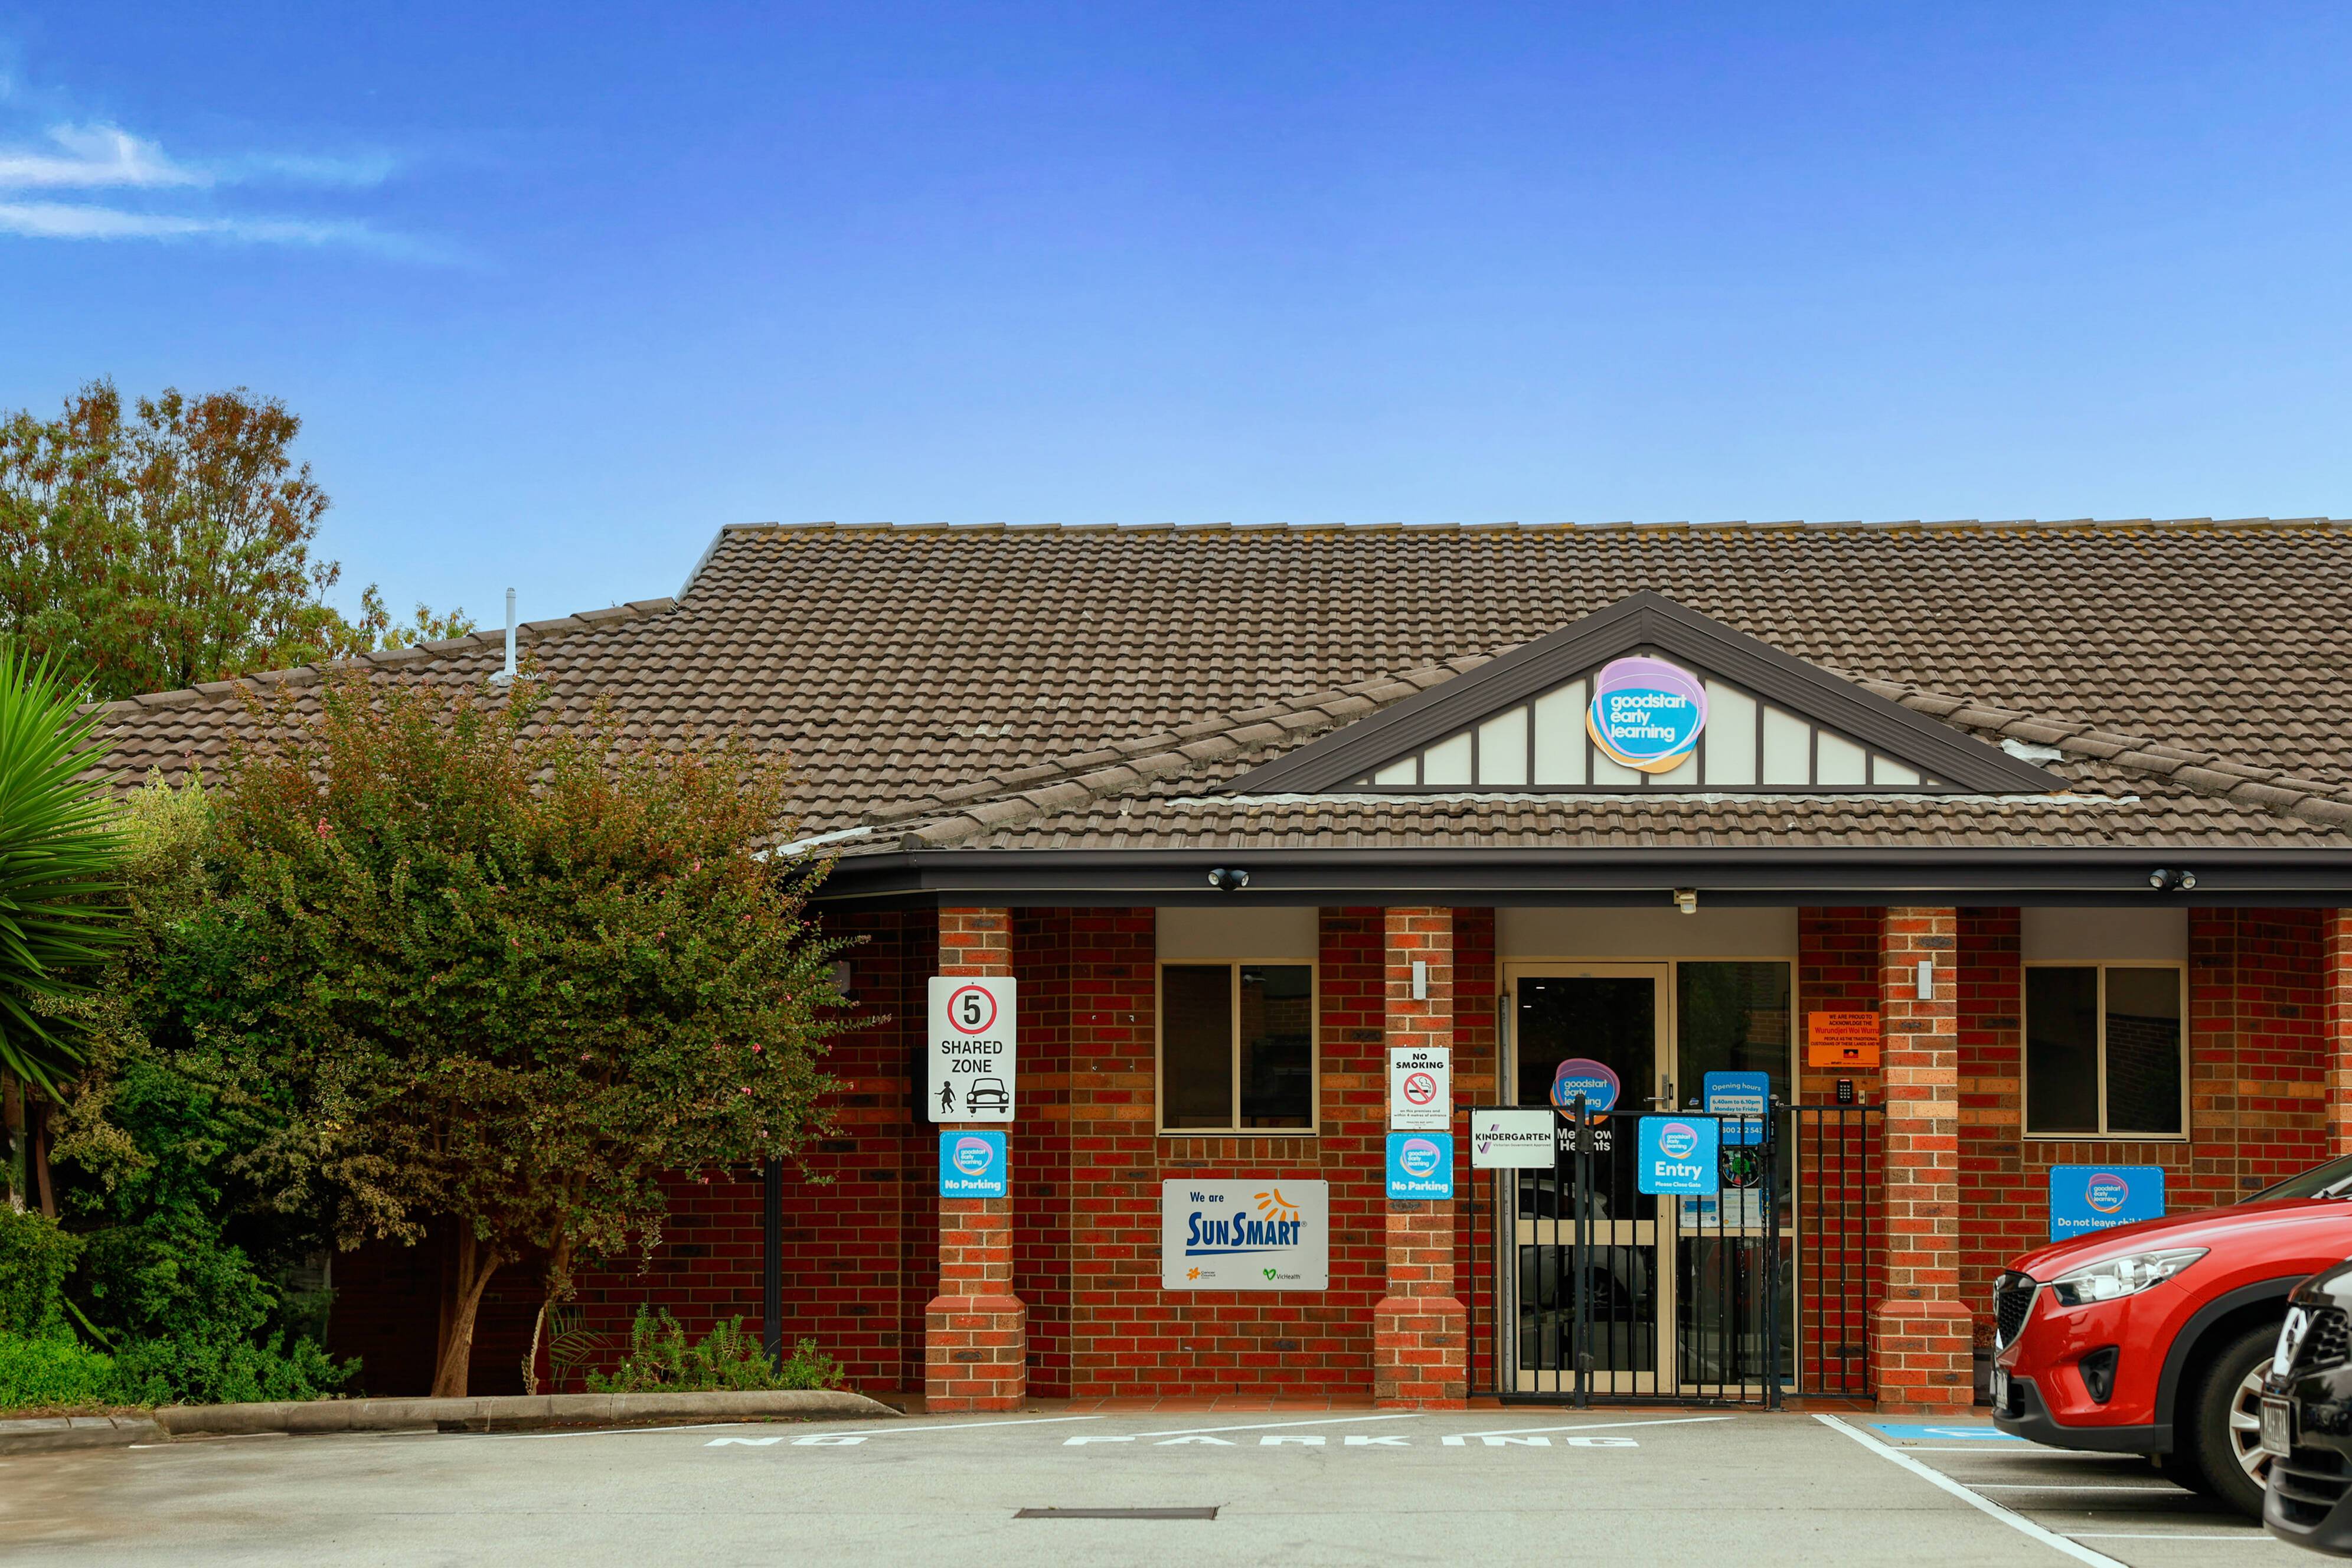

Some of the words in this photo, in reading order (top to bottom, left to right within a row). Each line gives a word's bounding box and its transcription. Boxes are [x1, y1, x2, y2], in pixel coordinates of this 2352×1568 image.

[1611, 694, 1687, 711] goodstart
[1611, 708, 1650, 726] early
[1611, 724, 1675, 743] learning
[963, 995, 981, 1025] 5
[942, 1040, 1002, 1054] SHARED
[952, 1059, 992, 1073] ZONE
[1564, 1080, 1608, 1090] goodstart
[1712, 1083, 1741, 1091] Opening
[1742, 1083, 1761, 1091] hours
[1564, 1089, 1586, 1097] early
[1557, 1128, 1612, 1139] Meow
[1655, 1161, 1702, 1181] Entry
[945, 1180, 960, 1189] No
[961, 1179, 1001, 1191] Parking
[1392, 1182, 1407, 1191] No
[1408, 1181, 1449, 1193] Parking
[1190, 1191, 1205, 1203] We
[1208, 1194, 1224, 1203] are
[2058, 1218, 2071, 1226] Do
[2092, 1217, 2116, 1228] leave
[704, 1436, 868, 1446] NO
[1063, 1435, 1639, 1446] PARKING
